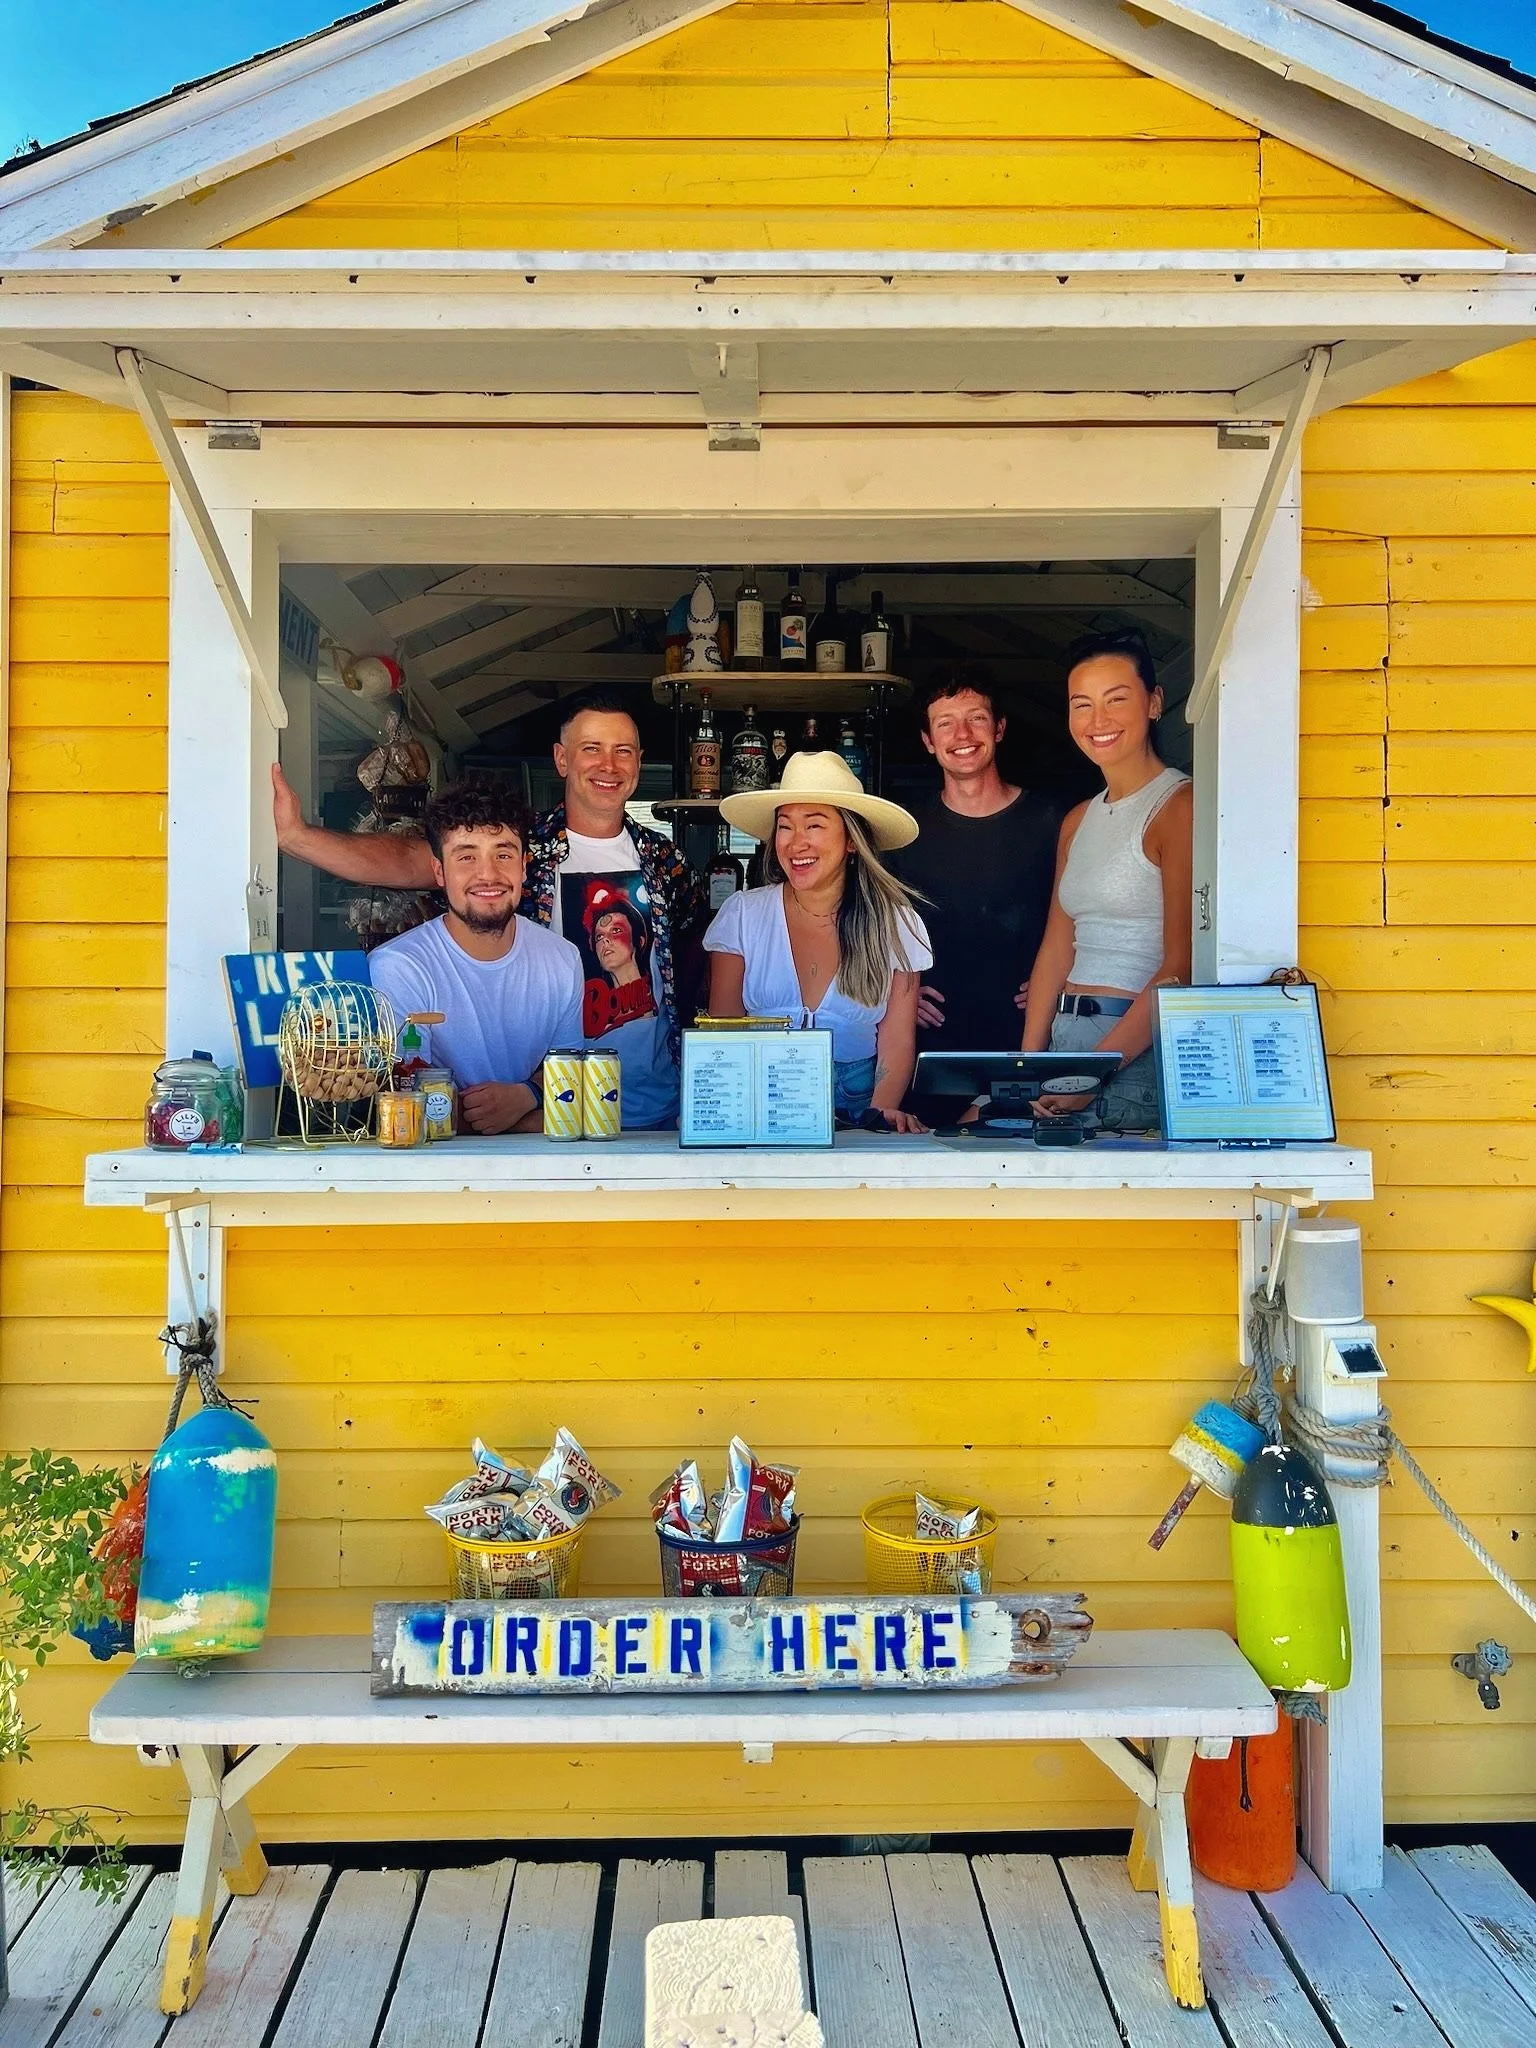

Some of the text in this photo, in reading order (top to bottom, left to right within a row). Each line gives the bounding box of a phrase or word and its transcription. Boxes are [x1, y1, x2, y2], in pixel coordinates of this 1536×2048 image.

[254, 951, 334, 996] KEY
[459, 1464, 488, 1502] ORTH
[470, 1470, 499, 1499] ORK
[449, 1507, 501, 1523] NORTH
[449, 1515, 501, 1534] FORK
[921, 1514, 954, 1531] NOR
[682, 1558, 732, 1571] FORK
[451, 1613, 956, 1675] ORDER HERE
